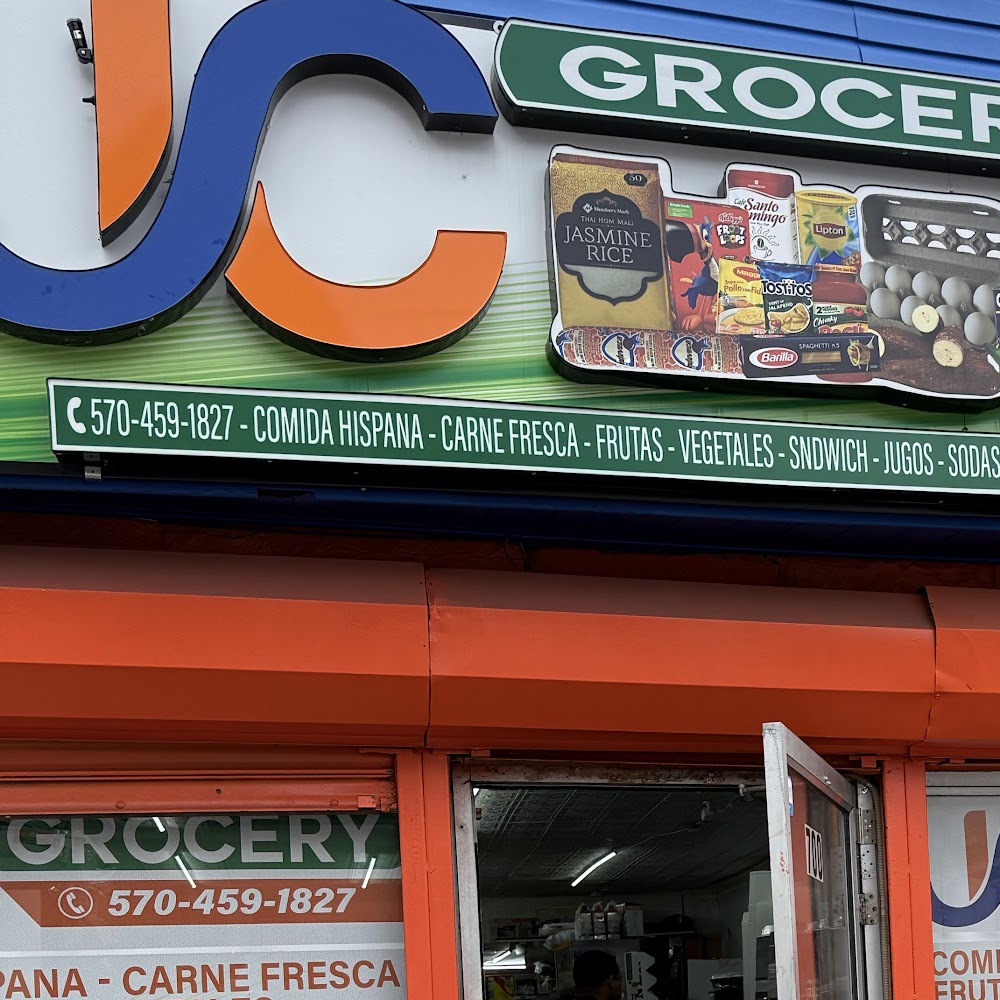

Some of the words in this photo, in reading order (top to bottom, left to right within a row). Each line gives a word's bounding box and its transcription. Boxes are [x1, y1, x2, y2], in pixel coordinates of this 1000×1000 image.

[744, 197, 779, 213] Santo
[581, 215, 596, 223] THAI
[598, 216, 615, 224] HOM
[748, 212, 786, 228] mingo
[563, 225, 652, 248] JASMINE
[815, 224, 844, 235] Lipton
[586, 244, 634, 264] RICE
[724, 283, 742, 293] Pollo
[751, 285, 762, 295] Fid
[799, 342, 830, 350] SPAGHETTI
[761, 352, 795, 363] Barilla
[90, 398, 234, 441] 570-459-1827
[253, 405, 334, 446] COMIDA
[339, 409, 424, 450] HISPANA
[441, 414, 505, 454] CARNE
[508, 418, 580, 458] FRESCA
[596, 424, 664, 463] FRUTAS
[678, 428, 774, 469] VEGETALES
[789, 435, 868, 473] SNDWICH
[883, 440, 934, 476] JUGOS
[948, 443, 1000, 479] SODAS
[6, 814, 381, 866] GROCERY
[107, 886, 357, 917] 570-459-1827
[122, 962, 250, 996] CARNE
[261, 959, 401, 992] FRESCA
